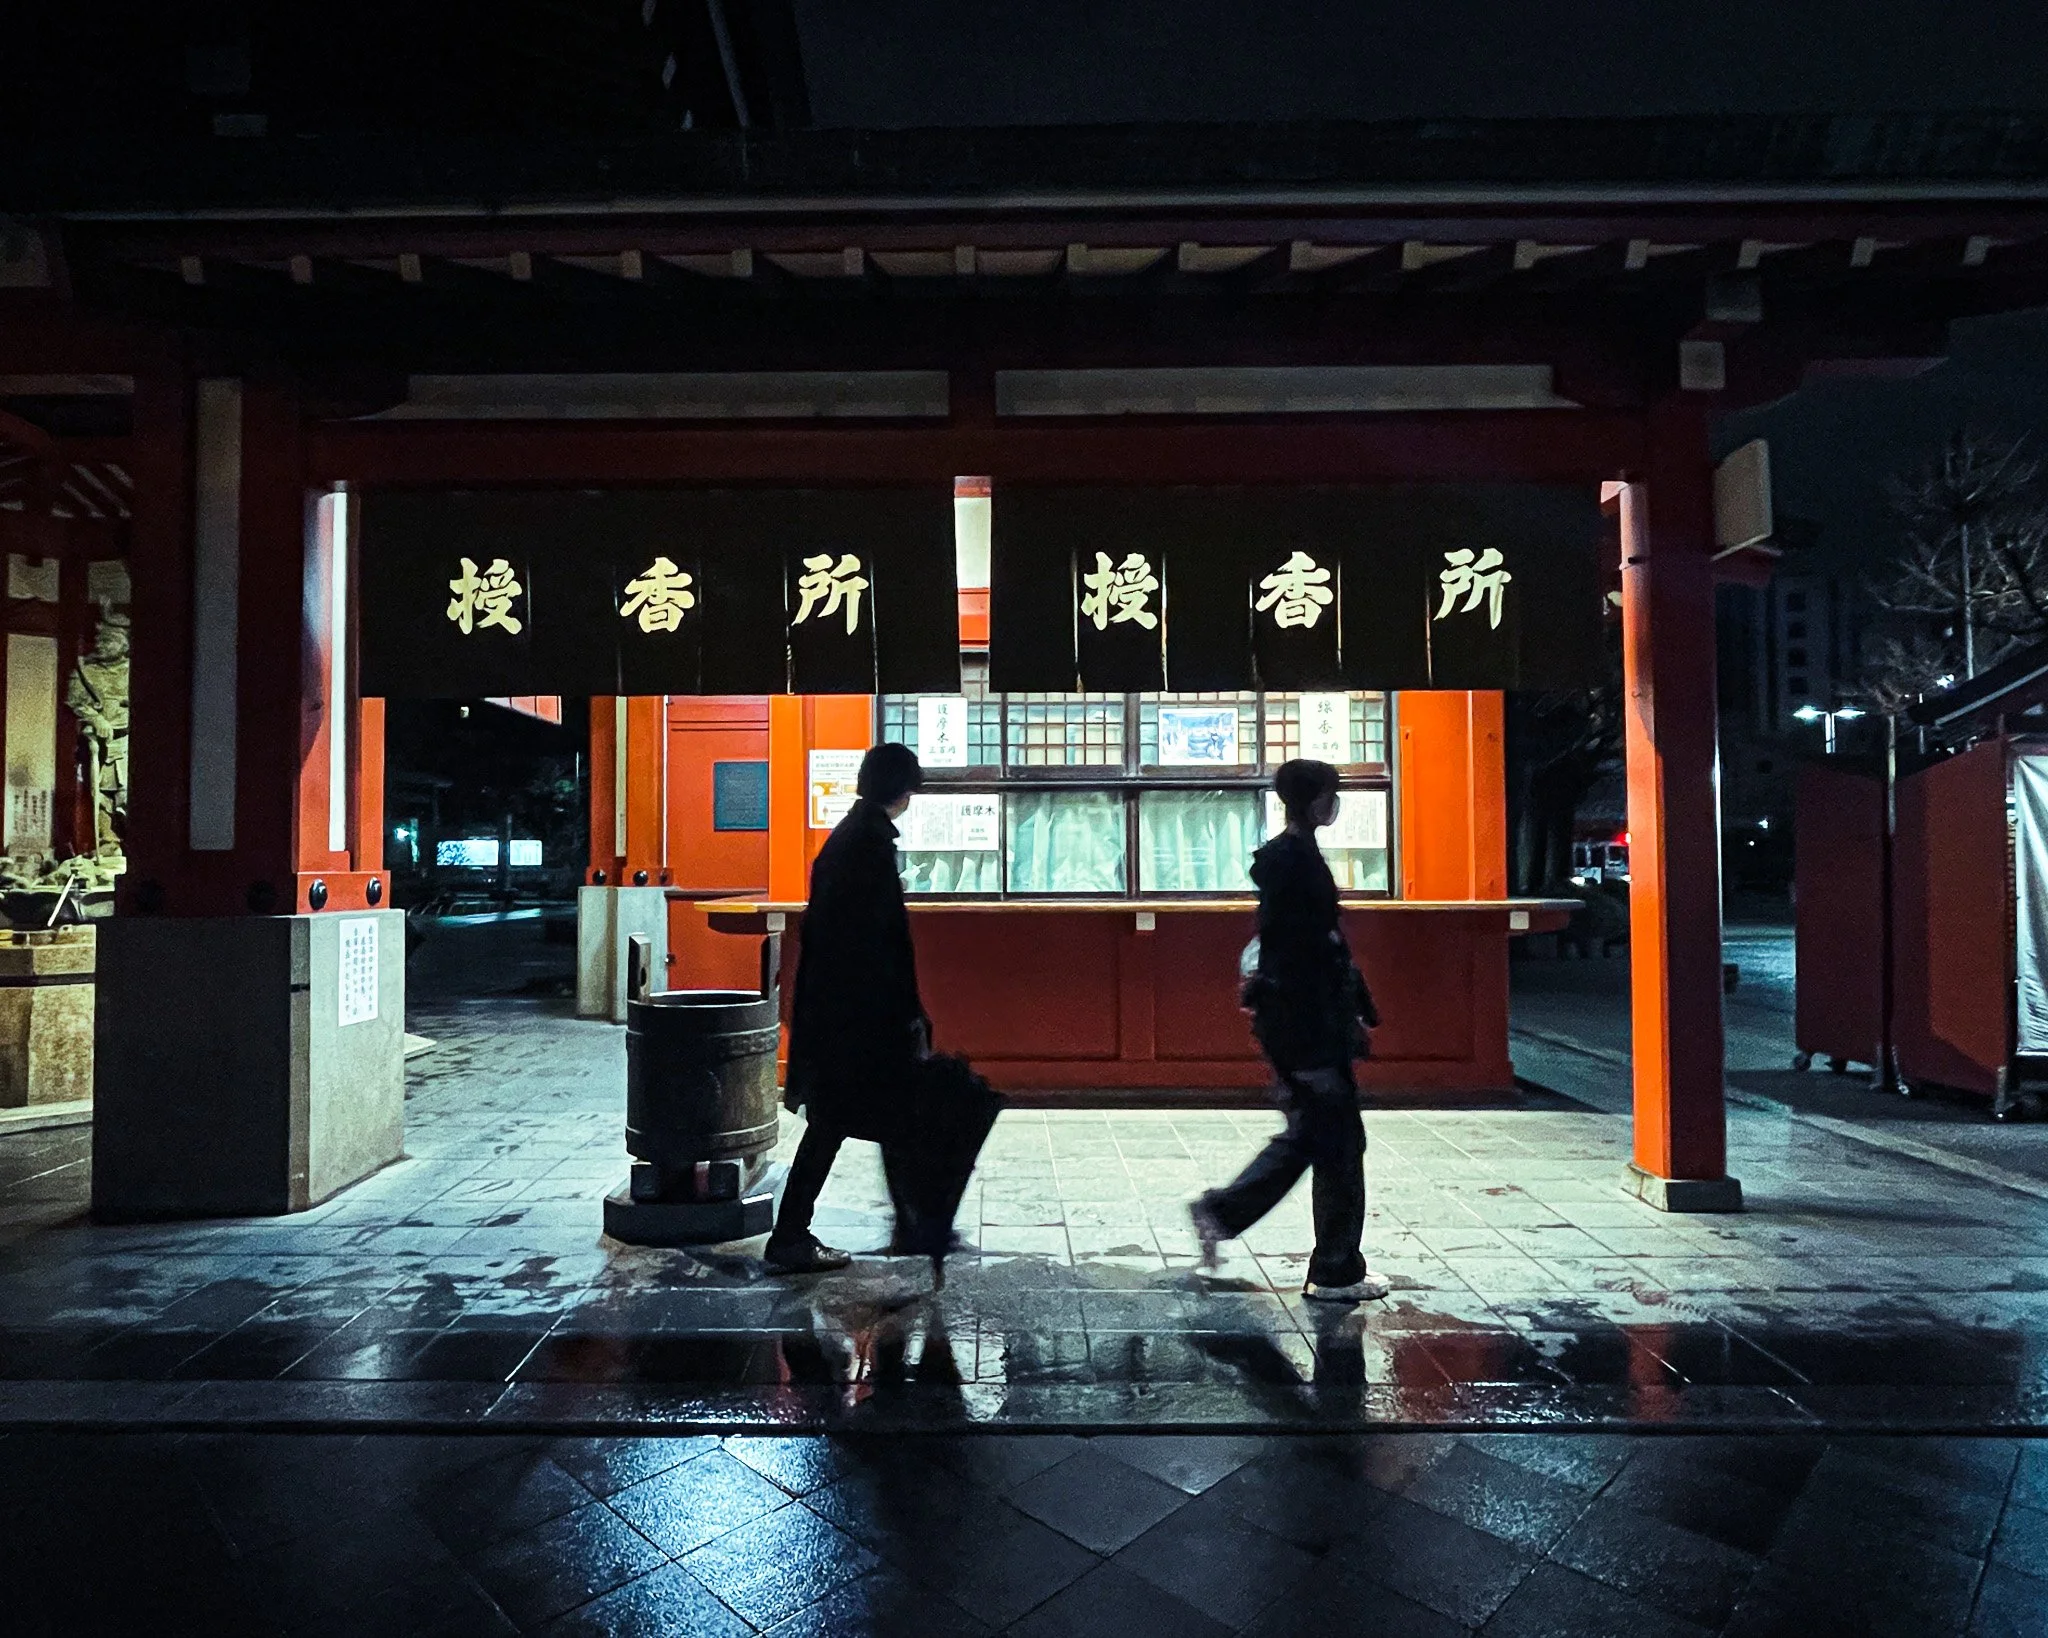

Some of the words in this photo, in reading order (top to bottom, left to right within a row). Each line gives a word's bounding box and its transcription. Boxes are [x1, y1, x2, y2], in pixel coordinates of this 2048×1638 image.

[447, 555, 870, 636] 授香所
[1081, 548, 1512, 631] 授香所
